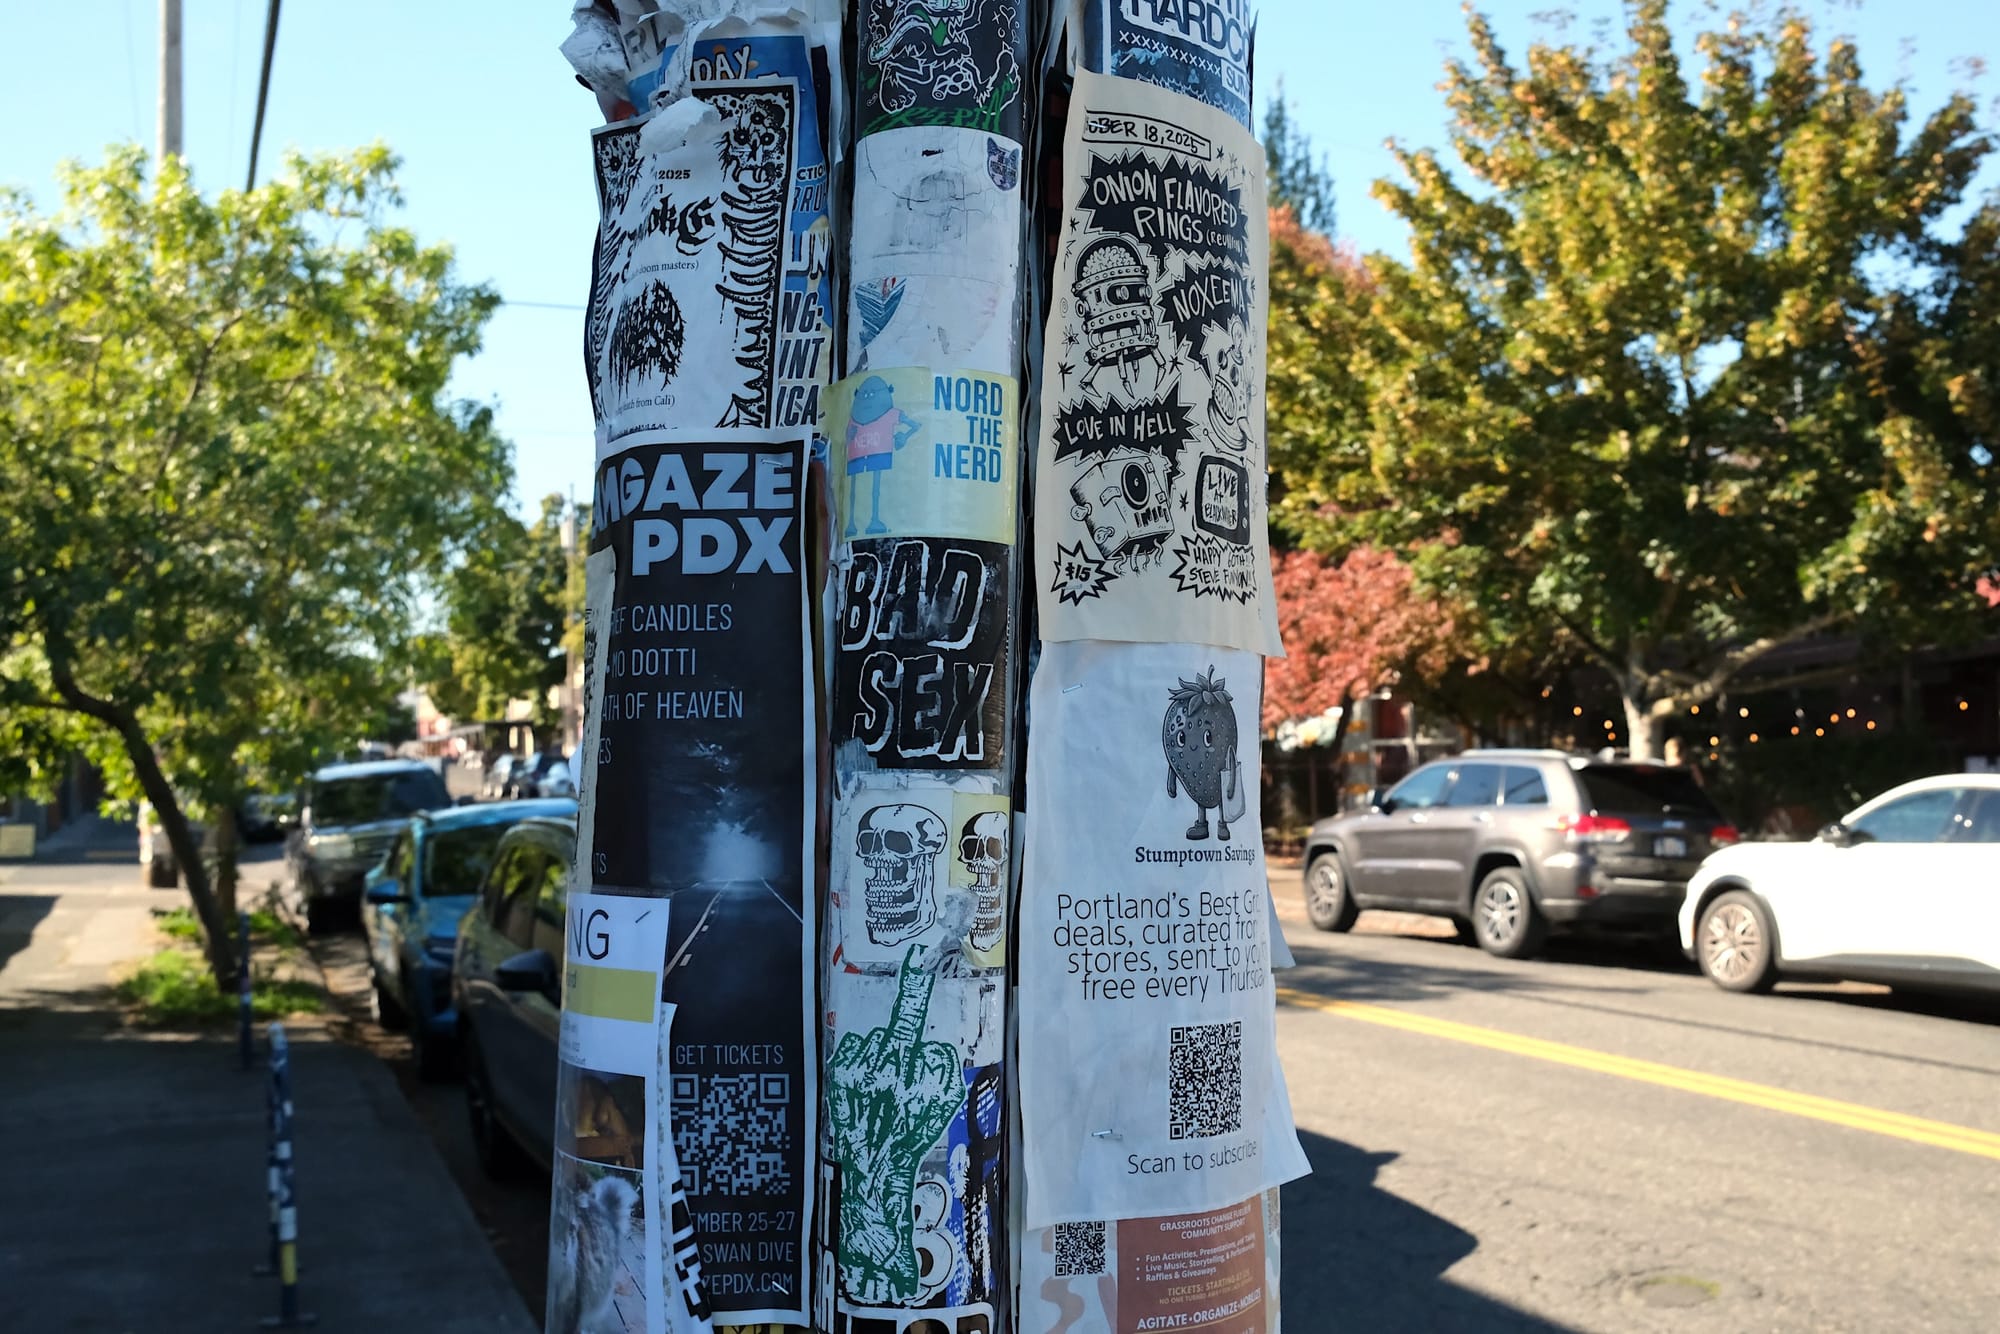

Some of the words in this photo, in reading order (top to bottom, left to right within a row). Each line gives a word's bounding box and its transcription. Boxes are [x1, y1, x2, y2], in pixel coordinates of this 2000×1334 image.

[658, 170, 691, 180] 2025
[1093, 168, 1157, 206] ONION
[1164, 177, 1237, 227] FLAVORED
[1133, 207, 1203, 243] RINGS
[661, 260, 699, 272] masters)
[1172, 273, 1245, 322] NOXEEMA
[654, 394, 676, 408] Cali)
[934, 376, 1003, 417] NORD
[966, 416, 1003, 448] THE
[1064, 417, 1103, 445] LOVE
[1109, 415, 1126, 437] IN
[1133, 410, 1176, 442] HELL
[934, 443, 1001, 483] NERD
[1208, 466, 1237, 497] LIVE
[632, 516, 795, 577] PDX
[1193, 547, 1221, 567] HAPPY
[1065, 562, 1091, 581] $15
[1189, 566, 1221, 585] STEVE
[841, 540, 987, 651] BAD
[631, 603, 733, 632] CANDLES
[631, 648, 697, 677] DOTTI
[625, 692, 649, 720] OF
[656, 690, 744, 720] HEAVEN
[852, 651, 994, 762] SEX
[1135, 846, 1222, 867] Stumptown
[1225, 845, 1256, 866] Savings
[1058, 892, 1191, 920] Portland's
[1200, 891, 1239, 917] Best
[1054, 919, 1134, 948] deals,
[1143, 914, 1231, 945] curated
[1067, 947, 1159, 975] stores,
[1168, 943, 1217, 970] sent
[1225, 942, 1241, 967] to
[1081, 972, 1136, 1000] free
[1146, 974, 1209, 1003] every
[675, 1045, 706, 1065] GET
[713, 1044, 784, 1064] TICKETS
[1128, 1154, 1176, 1175] Scan
[1183, 1153, 1204, 1171] to
[1210, 1138, 1257, 1169] subscribe
[748, 1211, 796, 1231] 25-27
[1160, 1216, 1211, 1232] GRASSROOTS
[703, 1243, 751, 1264] SWAN
[758, 1242, 795, 1262] DIVE
[1146, 1254, 1160, 1263] Fun
[1146, 1263, 1162, 1273] Live
[1146, 1272, 1173, 1283] Raffles
[1137, 1313, 1188, 1330] AGITATE
